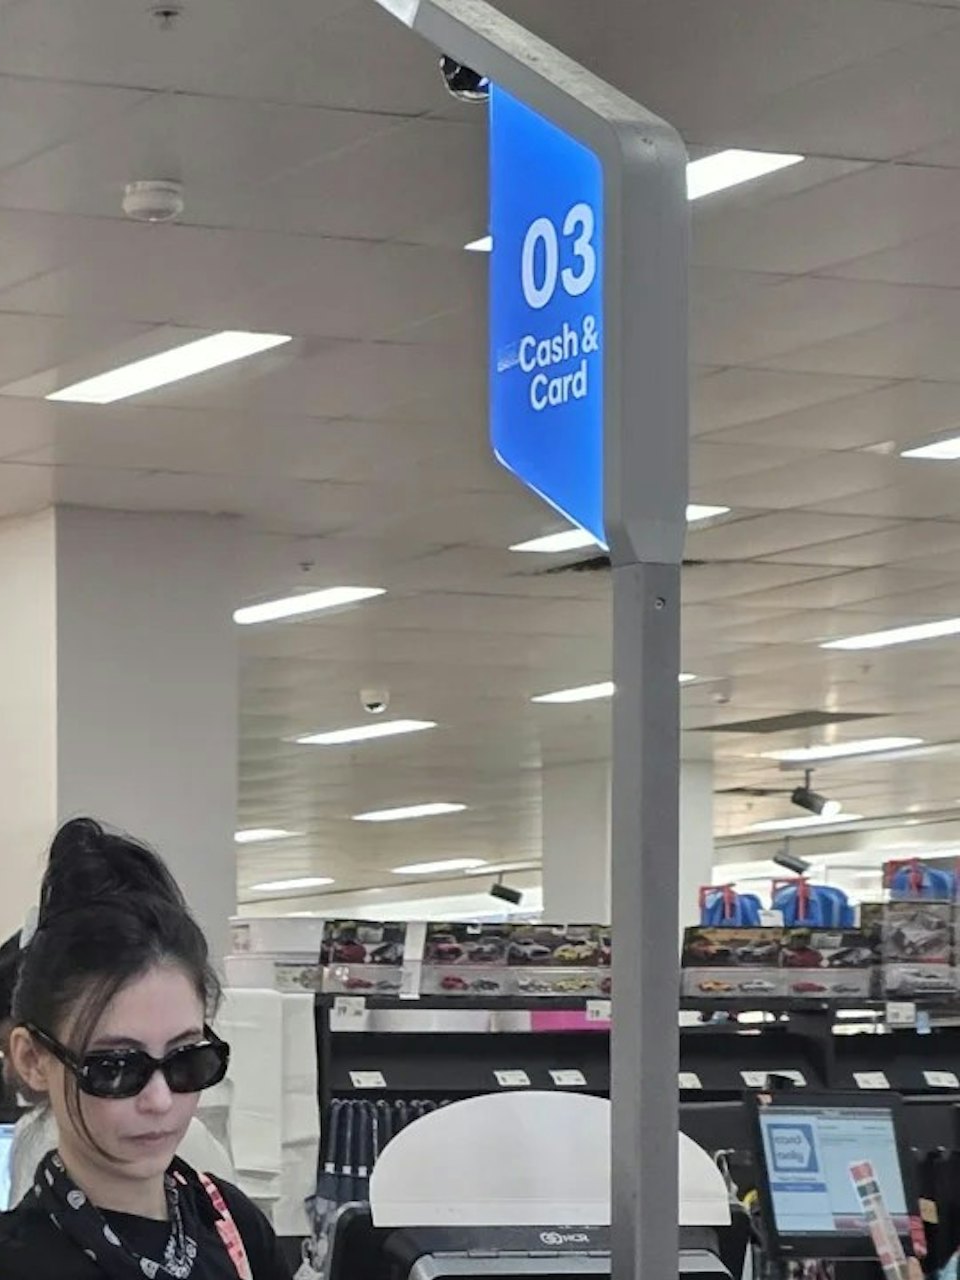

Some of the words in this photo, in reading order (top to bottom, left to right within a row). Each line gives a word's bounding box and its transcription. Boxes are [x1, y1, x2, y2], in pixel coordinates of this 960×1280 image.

[521, 202, 597, 309] 03
[519, 322, 579, 373] Cash
[581, 314, 598, 354] &
[530, 359, 587, 411] Card
